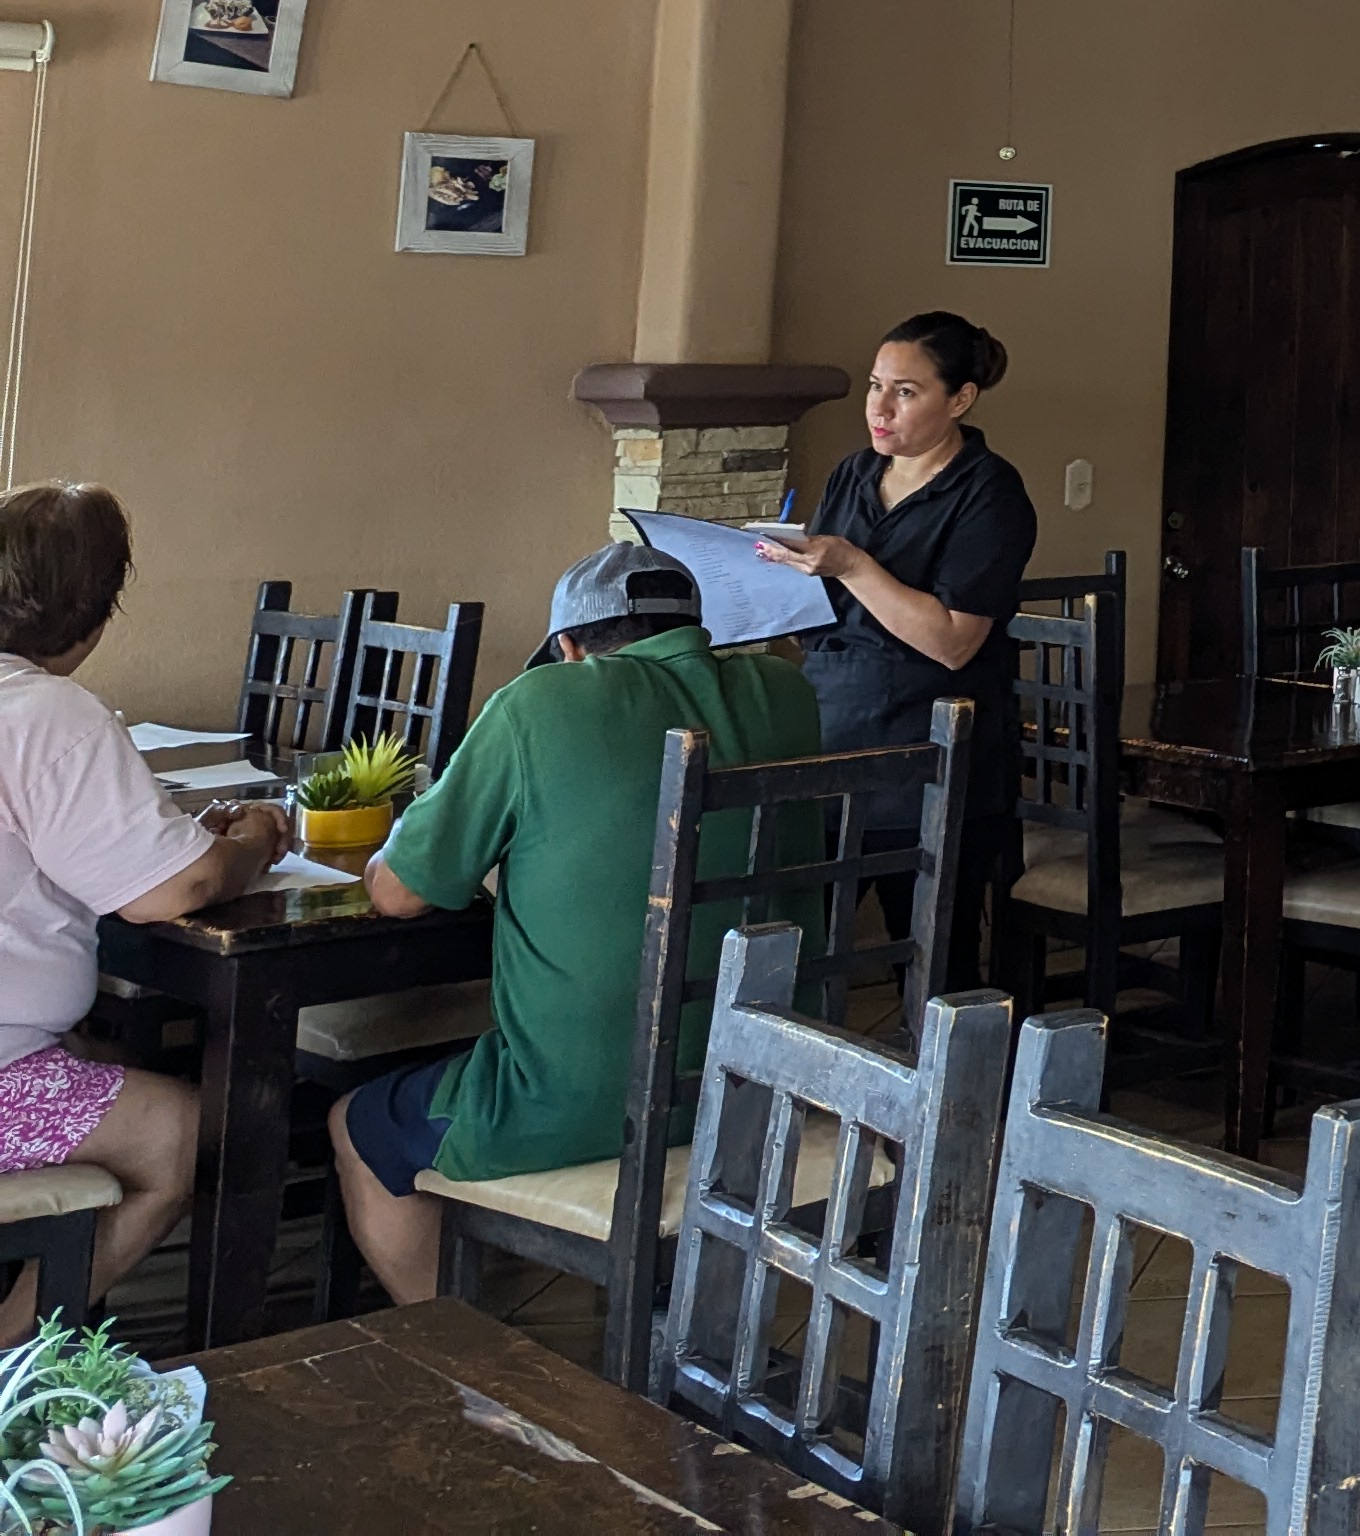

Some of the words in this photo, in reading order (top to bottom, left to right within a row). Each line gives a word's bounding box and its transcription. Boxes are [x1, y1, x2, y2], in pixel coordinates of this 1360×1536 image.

[999, 198, 1025, 211] RUTA
[1027, 200, 1040, 212] DE
[960, 237, 1039, 251] EVACUACION
